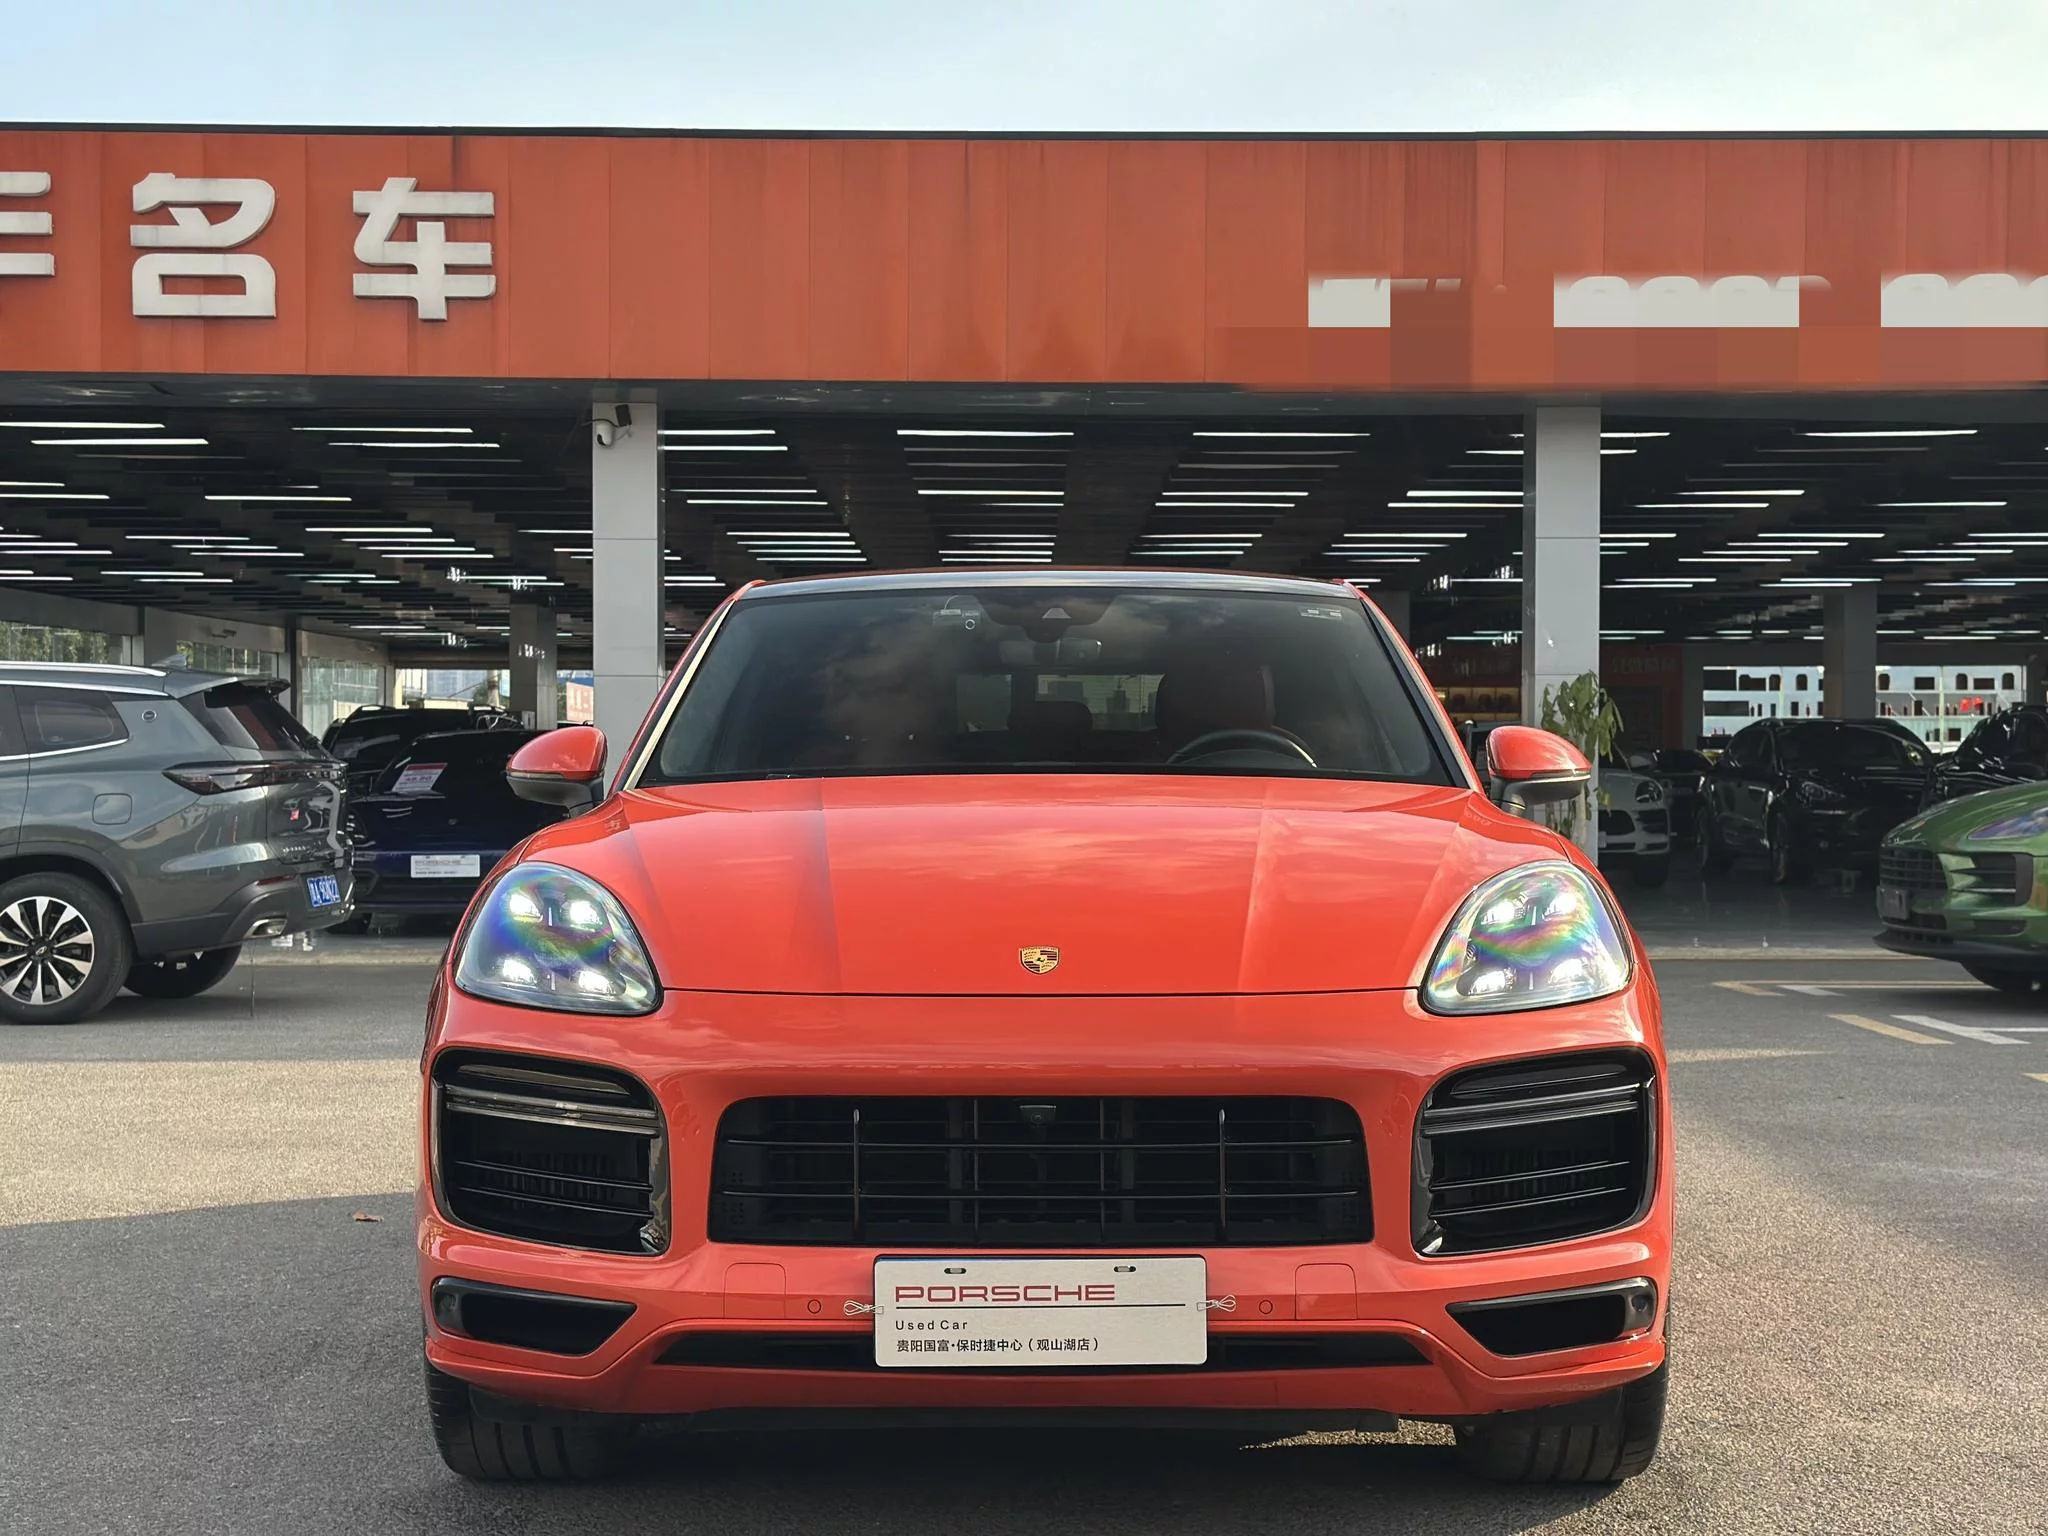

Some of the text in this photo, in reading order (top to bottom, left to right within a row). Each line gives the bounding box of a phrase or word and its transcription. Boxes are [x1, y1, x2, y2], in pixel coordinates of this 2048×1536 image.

[895, 1285, 1115, 1302] PORSCHE
[895, 1319, 968, 1331] Used Car
